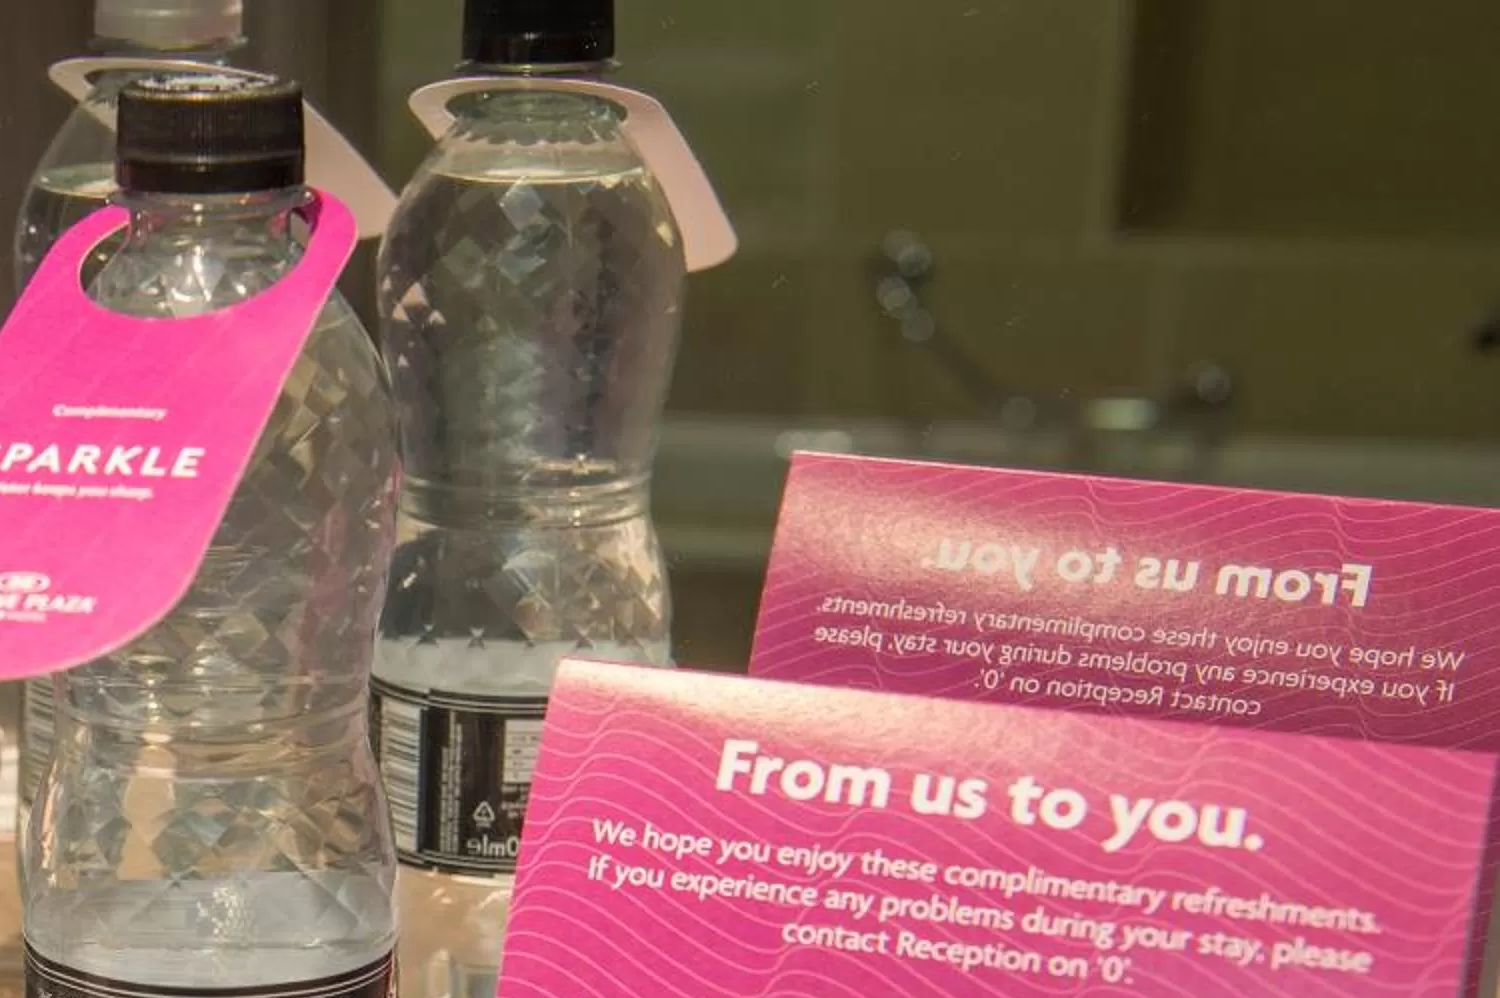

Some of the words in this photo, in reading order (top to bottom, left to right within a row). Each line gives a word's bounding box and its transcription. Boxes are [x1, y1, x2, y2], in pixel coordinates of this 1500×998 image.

[715, 738, 891, 811] From
[910, 767, 987, 820] us
[1007, 774, 1087, 830] to
[1102, 796, 1264, 853] you.
[587, 854, 611, 881] If
[611, 864, 665, 891] you
[670, 870, 818, 907] experience
[823, 888, 874, 921] any
[878, 893, 1014, 931] problems
[1021, 908, 1115, 947] during
[1120, 924, 1194, 952] your
[1270, 935, 1373, 974] please
[592, 819, 637, 847] We
[643, 823, 713, 860] hope
[716, 838, 771, 864] you
[777, 845, 852, 879] enjoy
[860, 848, 938, 882] these
[944, 863, 1165, 914] complimentary
[1172, 887, 1381, 935] refreshments.
[781, 922, 890, 954] contact
[895, 930, 1041, 974] Reception
[1048, 956, 1088, 980] on
